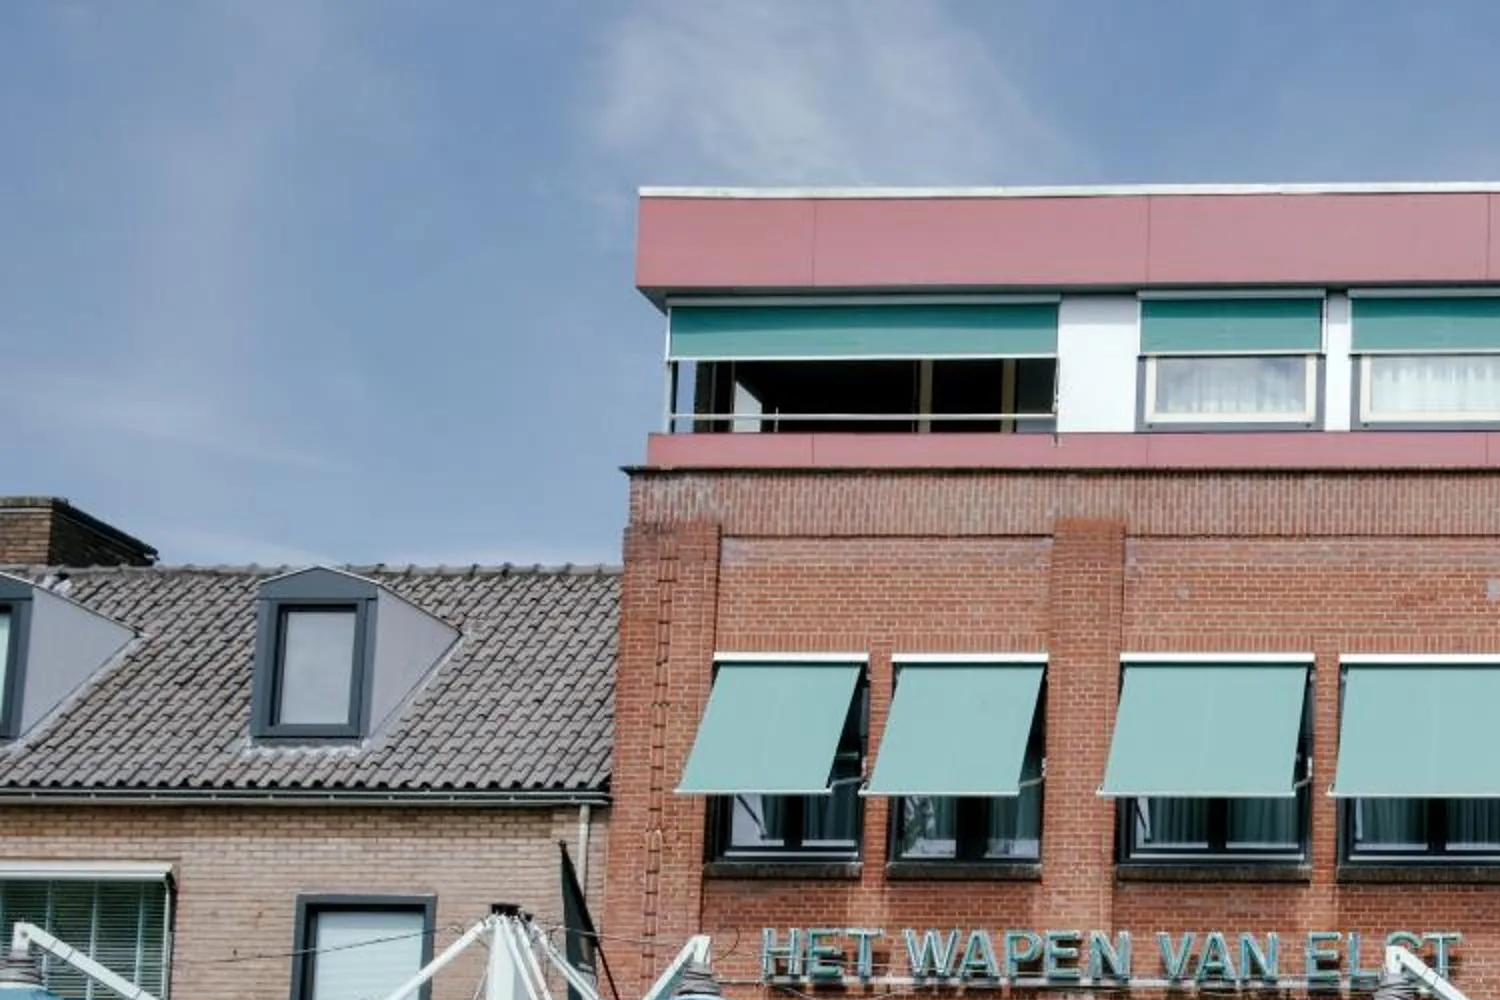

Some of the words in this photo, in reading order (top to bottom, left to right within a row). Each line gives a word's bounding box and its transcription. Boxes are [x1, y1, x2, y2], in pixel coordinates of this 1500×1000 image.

[761, 926, 885, 978] HET
[902, 929, 1133, 980] WAPEN
[1156, 931, 1279, 984] VAN
